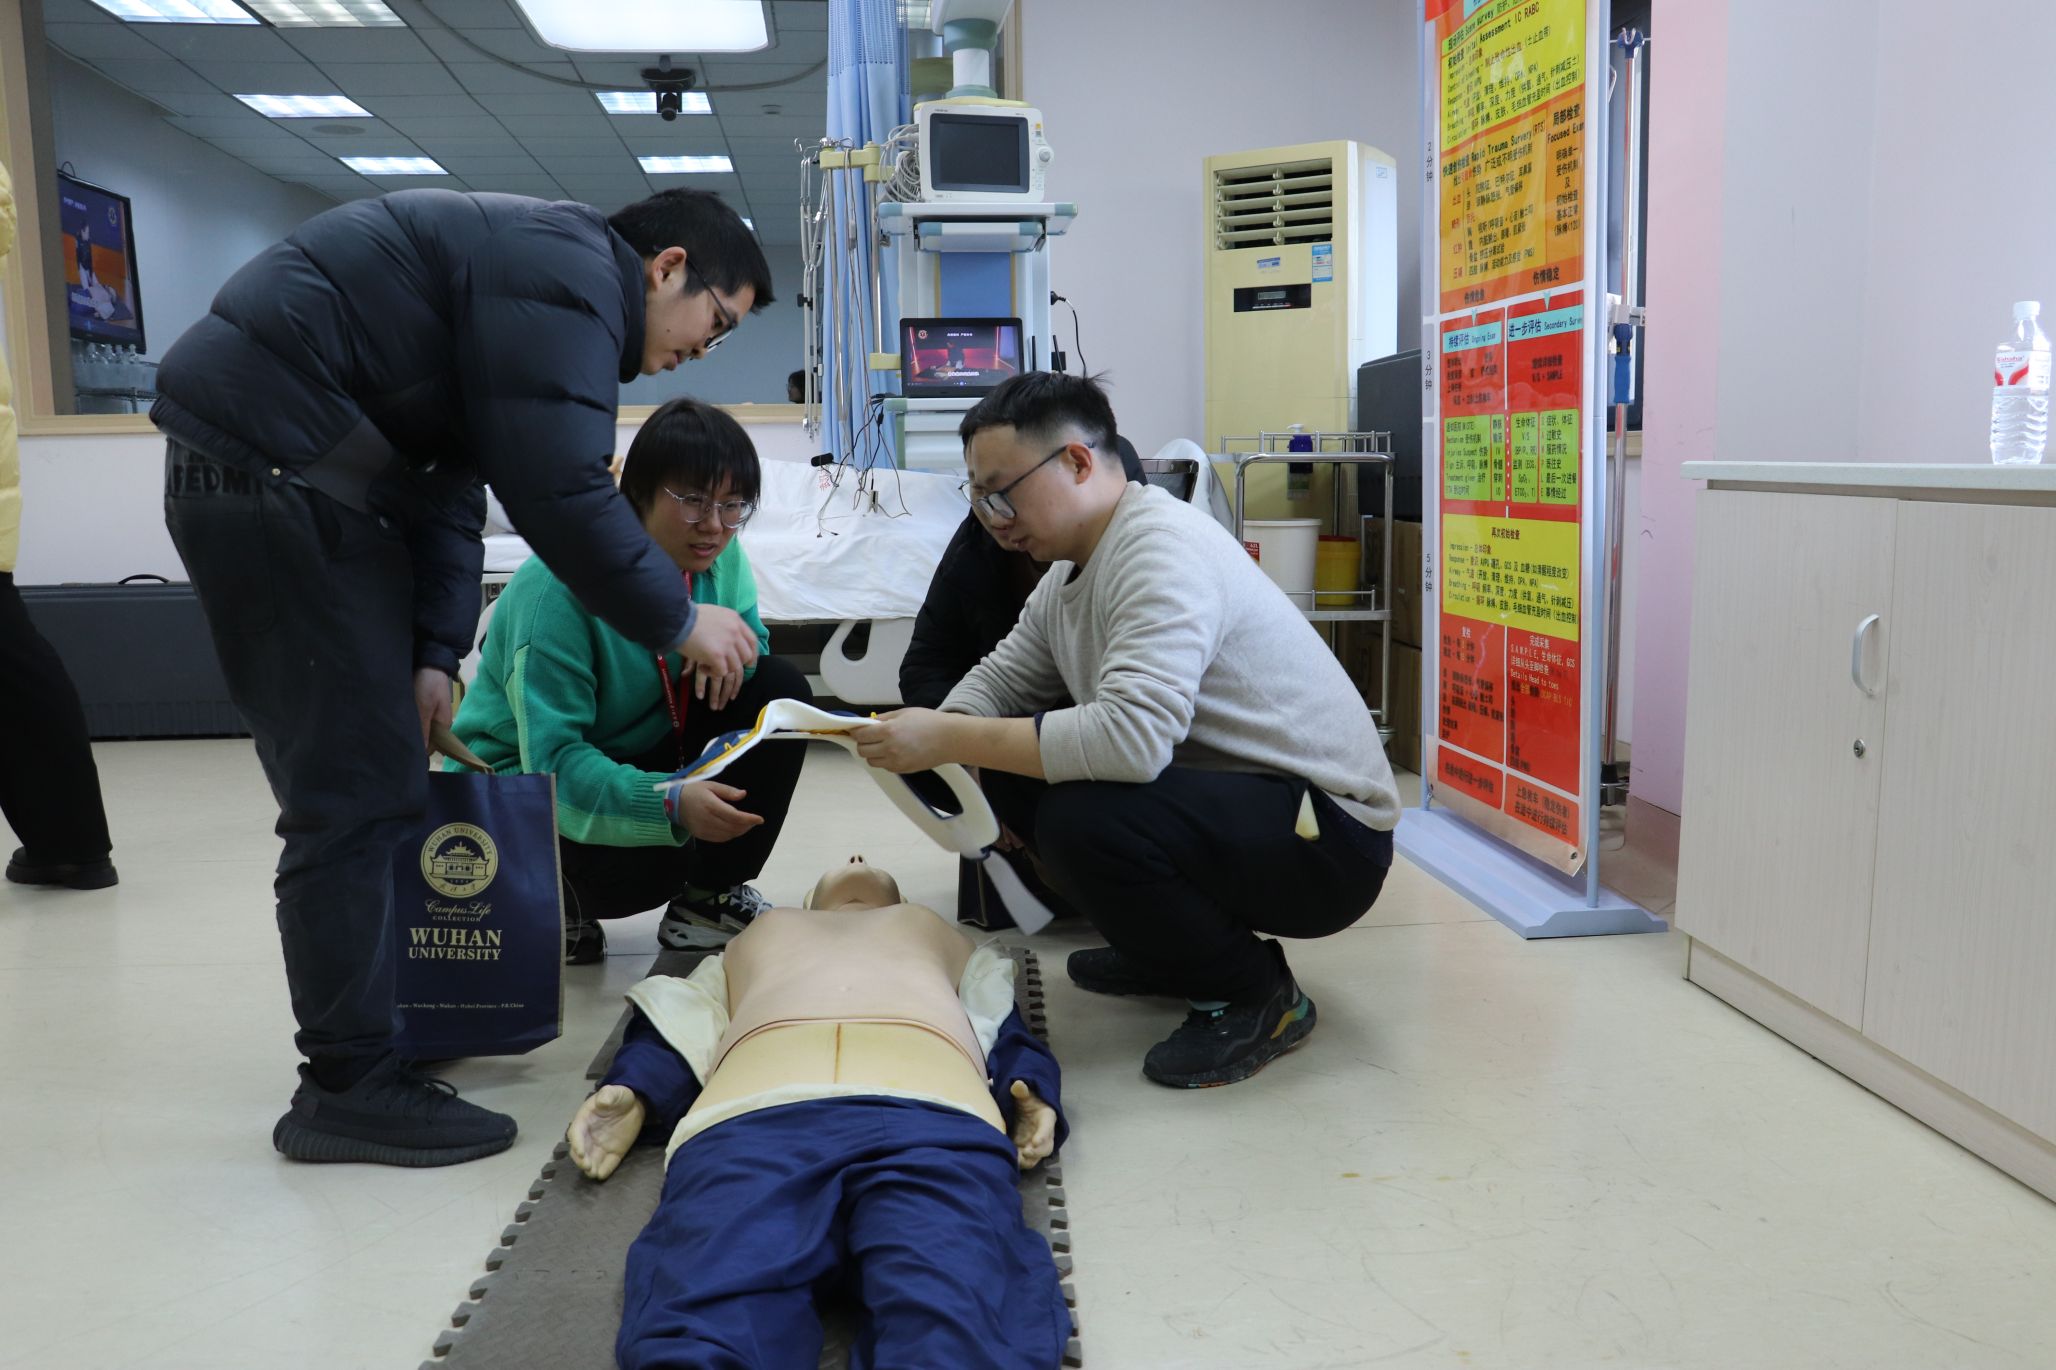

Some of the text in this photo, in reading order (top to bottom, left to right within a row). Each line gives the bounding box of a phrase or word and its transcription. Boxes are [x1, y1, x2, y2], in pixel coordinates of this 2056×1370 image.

[1477, 9, 1494, 27] survey
[1479, 19, 1511, 43] Assessment
[1524, 2, 1540, 19] RABC
[1553, 104, 1581, 127] 局部检查
[1488, 137, 1508, 155] Trauma
[1511, 130, 1532, 147] Survery
[1547, 129, 1570, 144] Focused
[1532, 267, 1560, 285] 伤情稳定
[1509, 319, 1542, 338] 进一步评估
[1544, 320, 1568, 330] Secondary
[1516, 417, 1536, 428] 生命体征
[1546, 472, 1577, 484] 最后一次进餐
[1491, 527, 1520, 540] 再次初始检查
[1529, 635, 1550, 649] 完成采集
[1528, 673, 1540, 684] Head
[1541, 678, 1546, 686] to
[428, 827, 493, 855] WUHAN UNIVERSITY
[425, 900, 492, 919] Campus Life
[409, 927, 503, 946] WUHAN
[408, 947, 502, 960] UNIVERSITY
